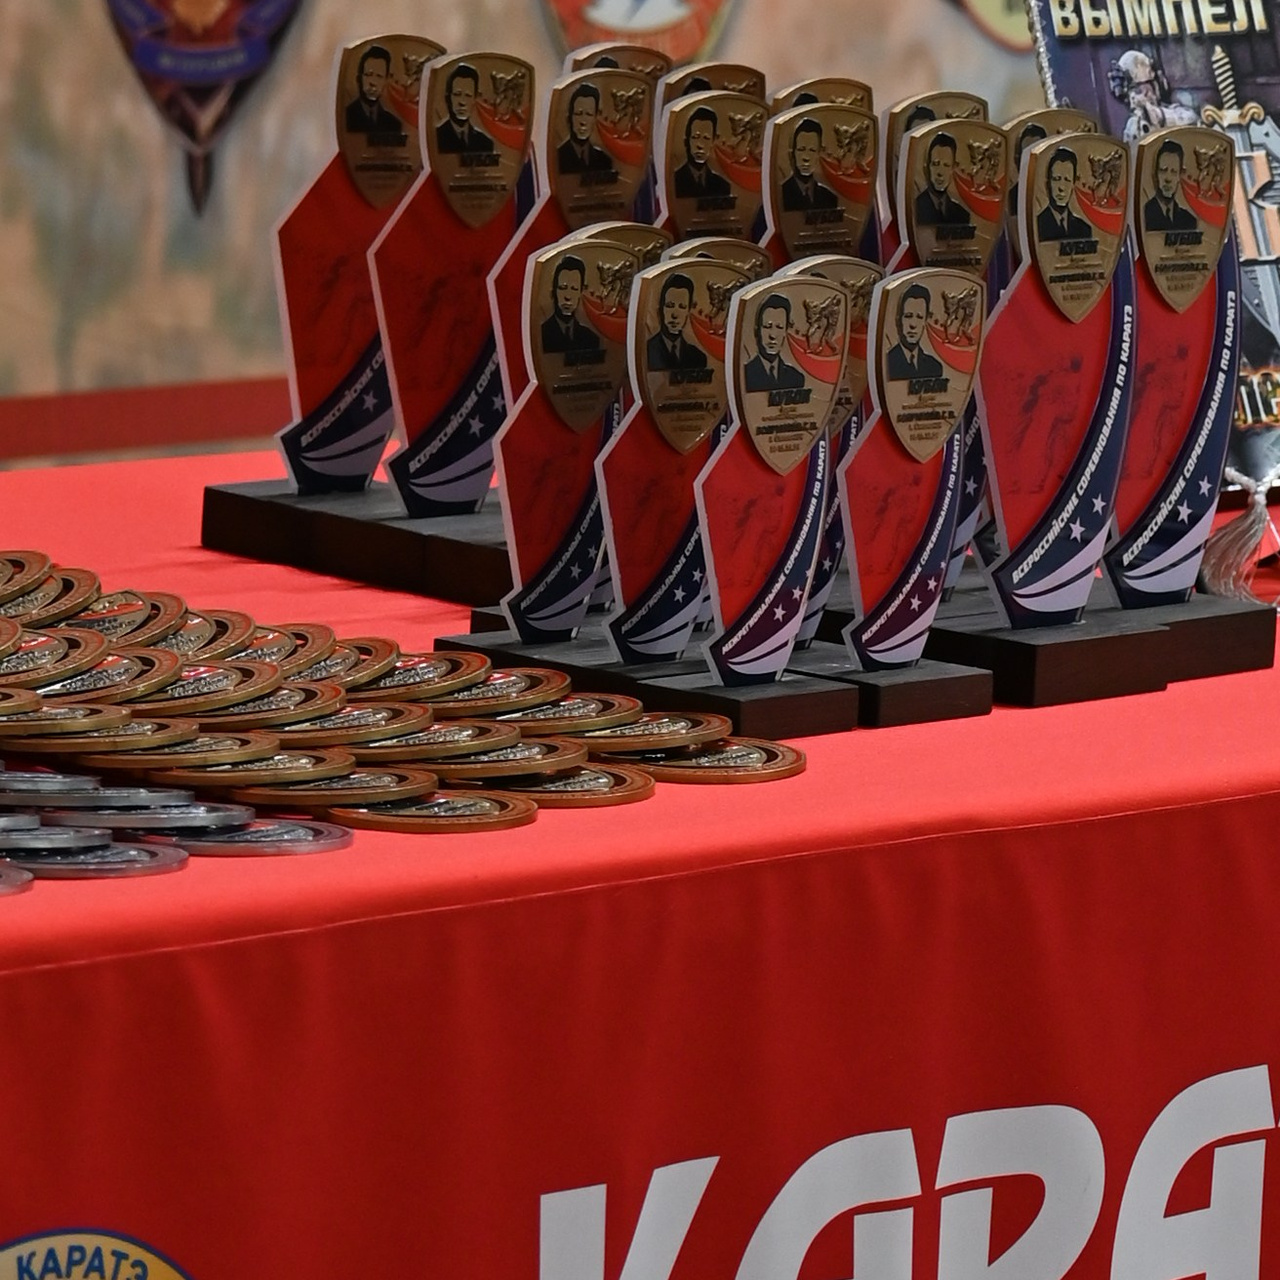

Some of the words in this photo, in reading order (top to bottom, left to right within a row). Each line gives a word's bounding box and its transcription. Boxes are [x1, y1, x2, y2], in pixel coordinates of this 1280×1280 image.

[1120, 305, 1133, 363] КАРАТЭ
[1221, 349, 1231, 370] ПО
[1223, 290, 1236, 347] КАРАТЭ
[1116, 364, 1127, 386] ПО
[1077, 389, 1121, 500] СОРЕВНОВАНИЯ
[1184, 371, 1226, 479] СОРЕВНОВАНИЯ
[784, 496, 818, 575] СОРЕВНОВАНИЯ
[816, 440, 826, 480] КАРАТЭ
[920, 489, 953, 566] СОРЕВНОВАНИЯ
[952, 434, 961, 472] КАРАТЭ
[1012, 495, 1079, 584] ВСЕРОССИЙСКИЕ
[1123, 479, 1187, 567] ВСЕРОССИЙСКИЕ
